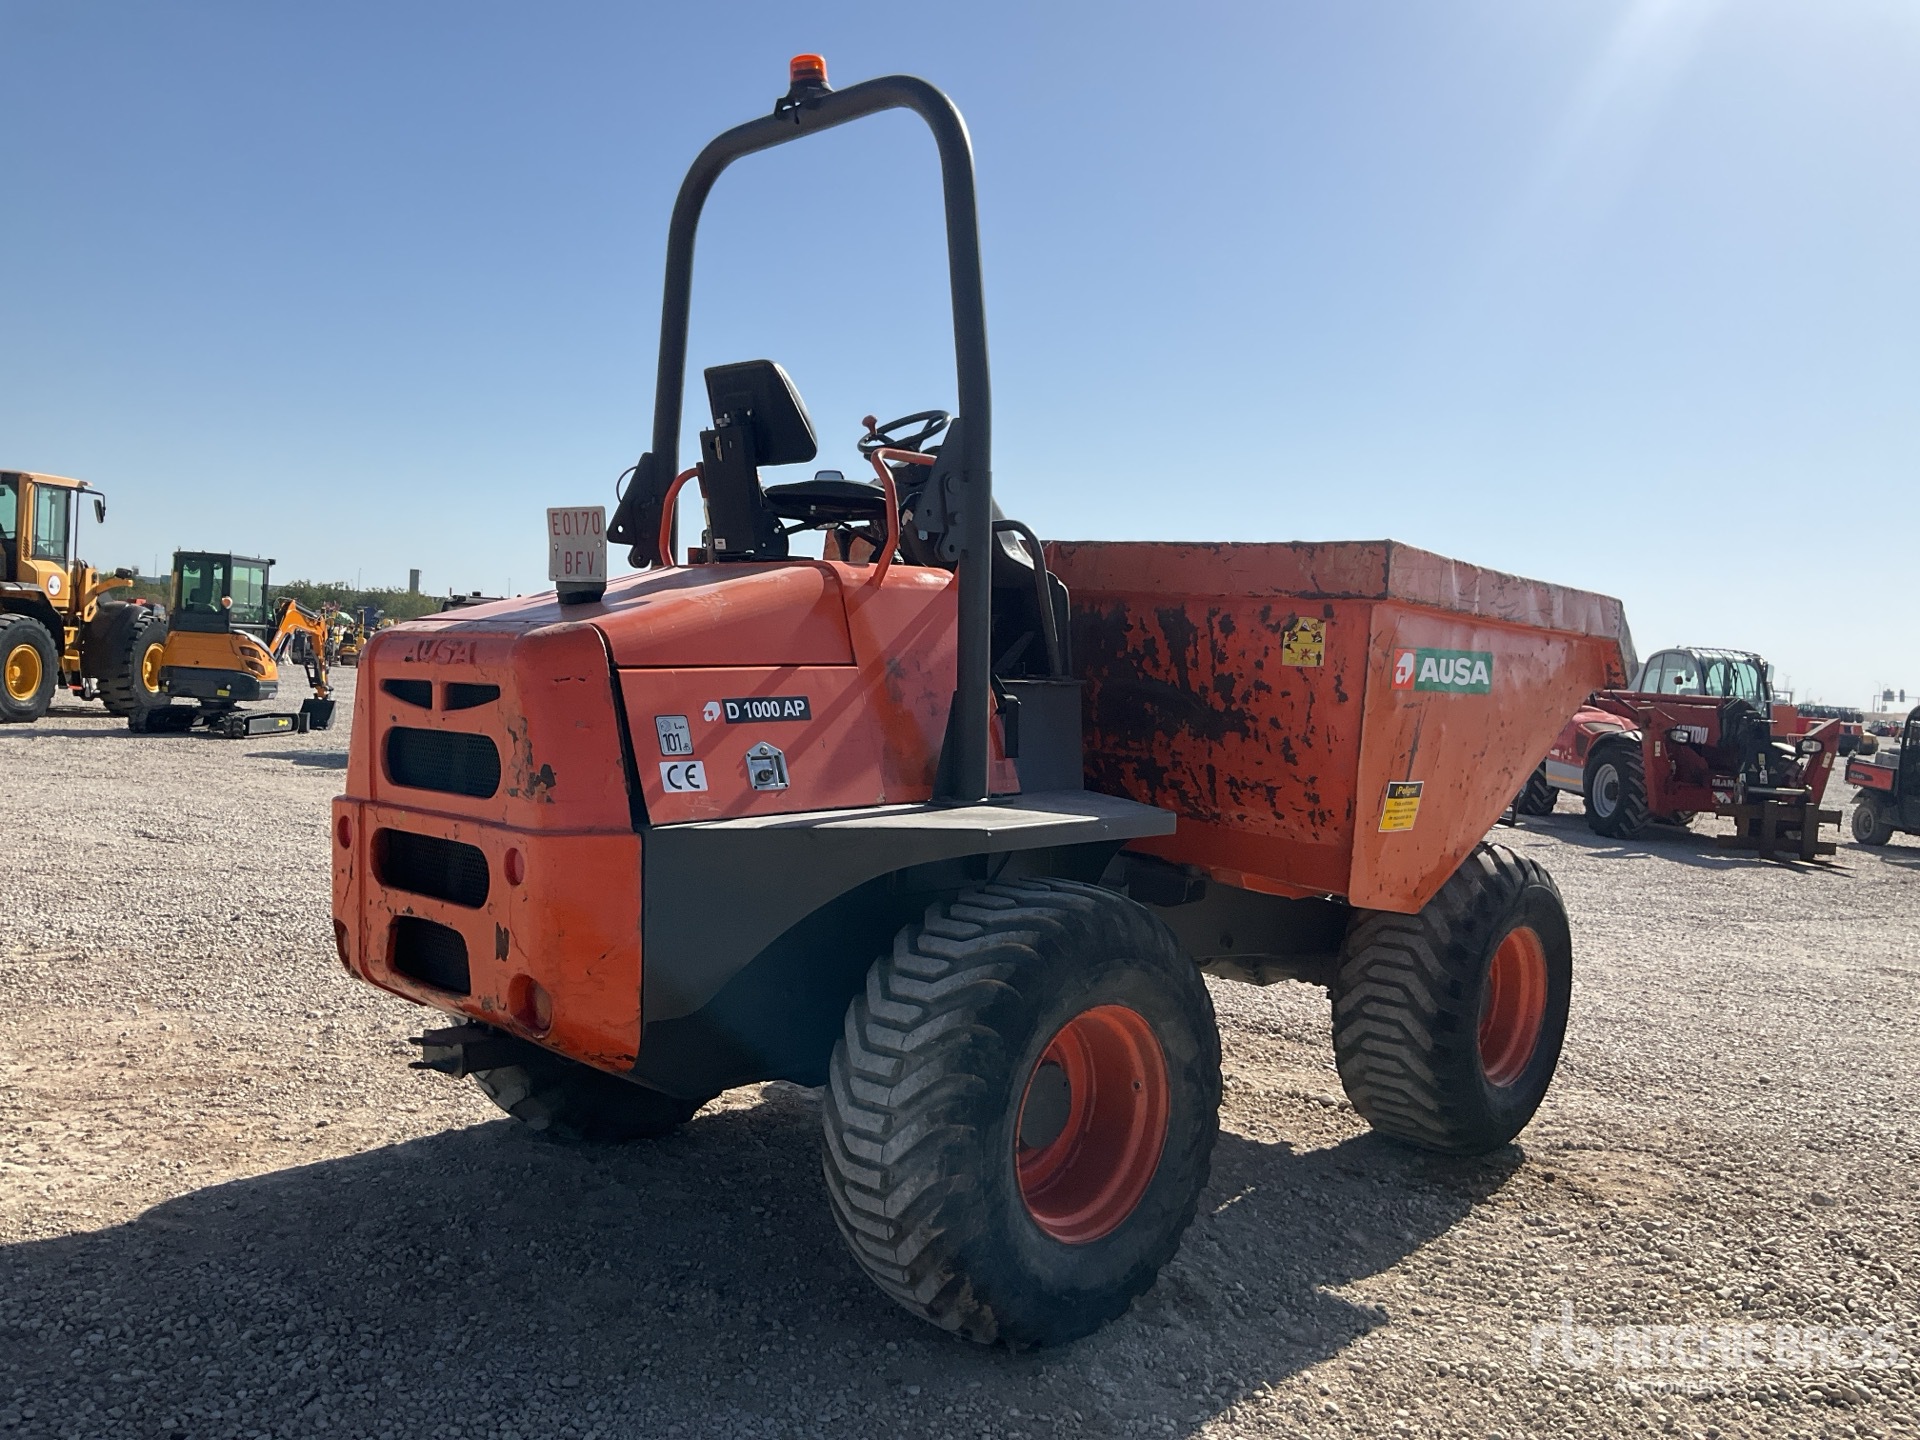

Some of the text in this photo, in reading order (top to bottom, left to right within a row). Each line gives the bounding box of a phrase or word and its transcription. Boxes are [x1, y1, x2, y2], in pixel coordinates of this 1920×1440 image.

[551, 511, 601, 536] E0170
[404, 639, 478, 665] AUSA
[1417, 657, 1490, 686] AUSA
[725, 699, 806, 719] D 1000 AP
[662, 732, 682, 752] 101
[666, 763, 701, 790] CE
